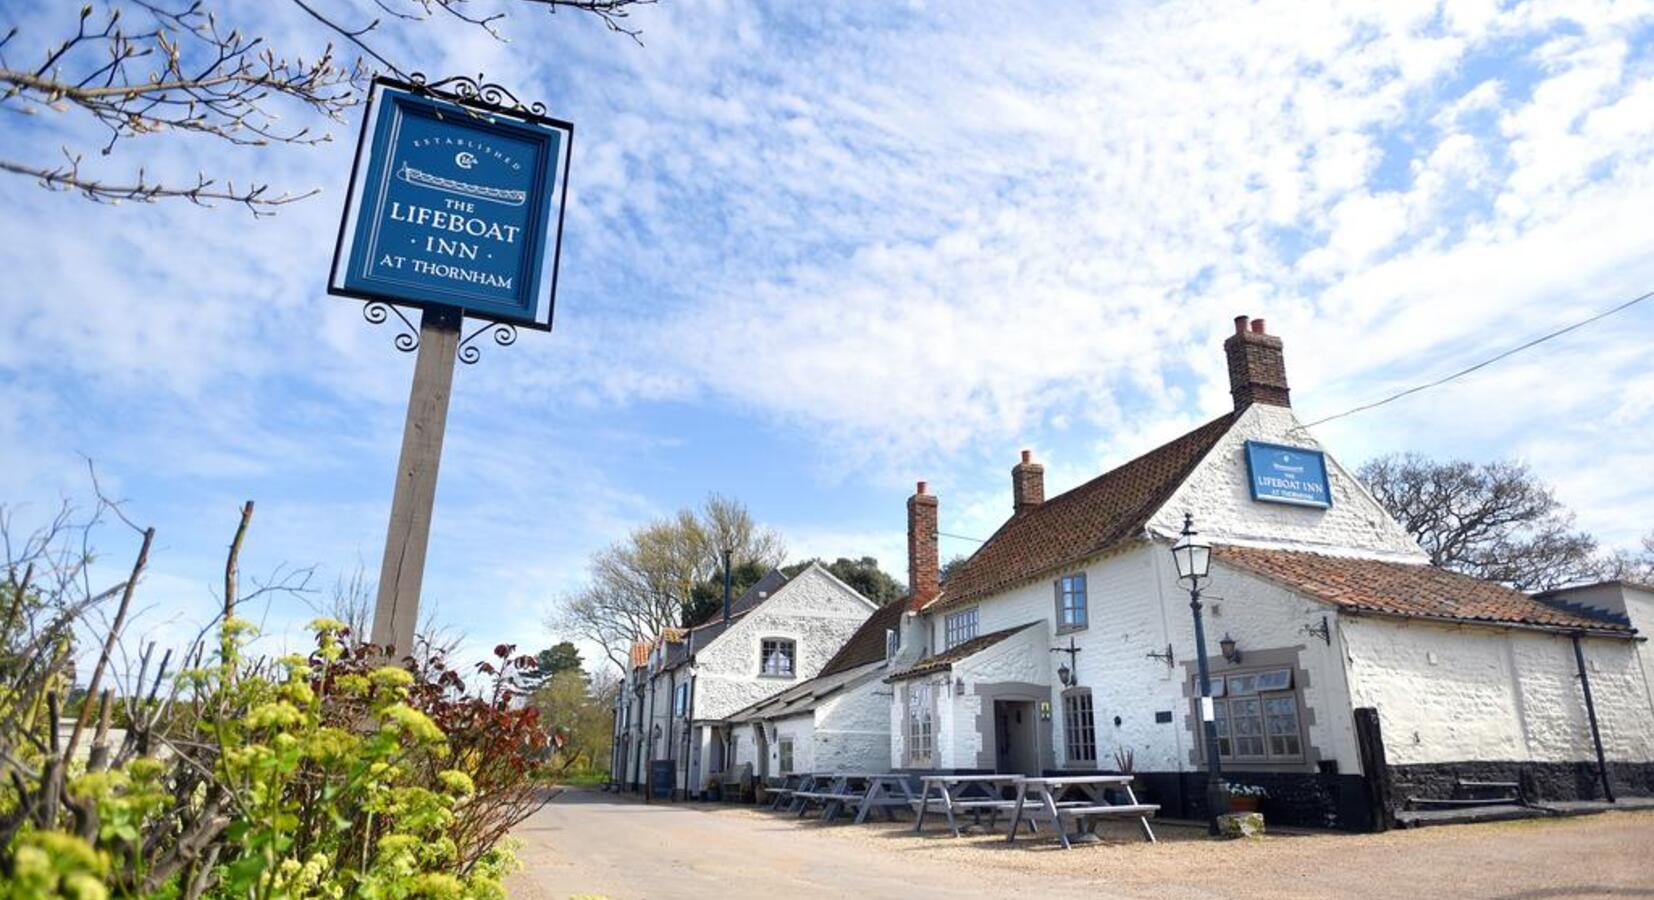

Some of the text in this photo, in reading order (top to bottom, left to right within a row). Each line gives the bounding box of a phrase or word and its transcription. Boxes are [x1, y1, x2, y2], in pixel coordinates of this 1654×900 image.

[413, 137, 521, 170] ESTABLISHED
[390, 202, 520, 243] LIFEBOAT
[445, 199, 475, 213] THE
[380, 254, 513, 289] AT THORNHAM
[1257, 475, 1323, 494] LIFEBOAT INN
